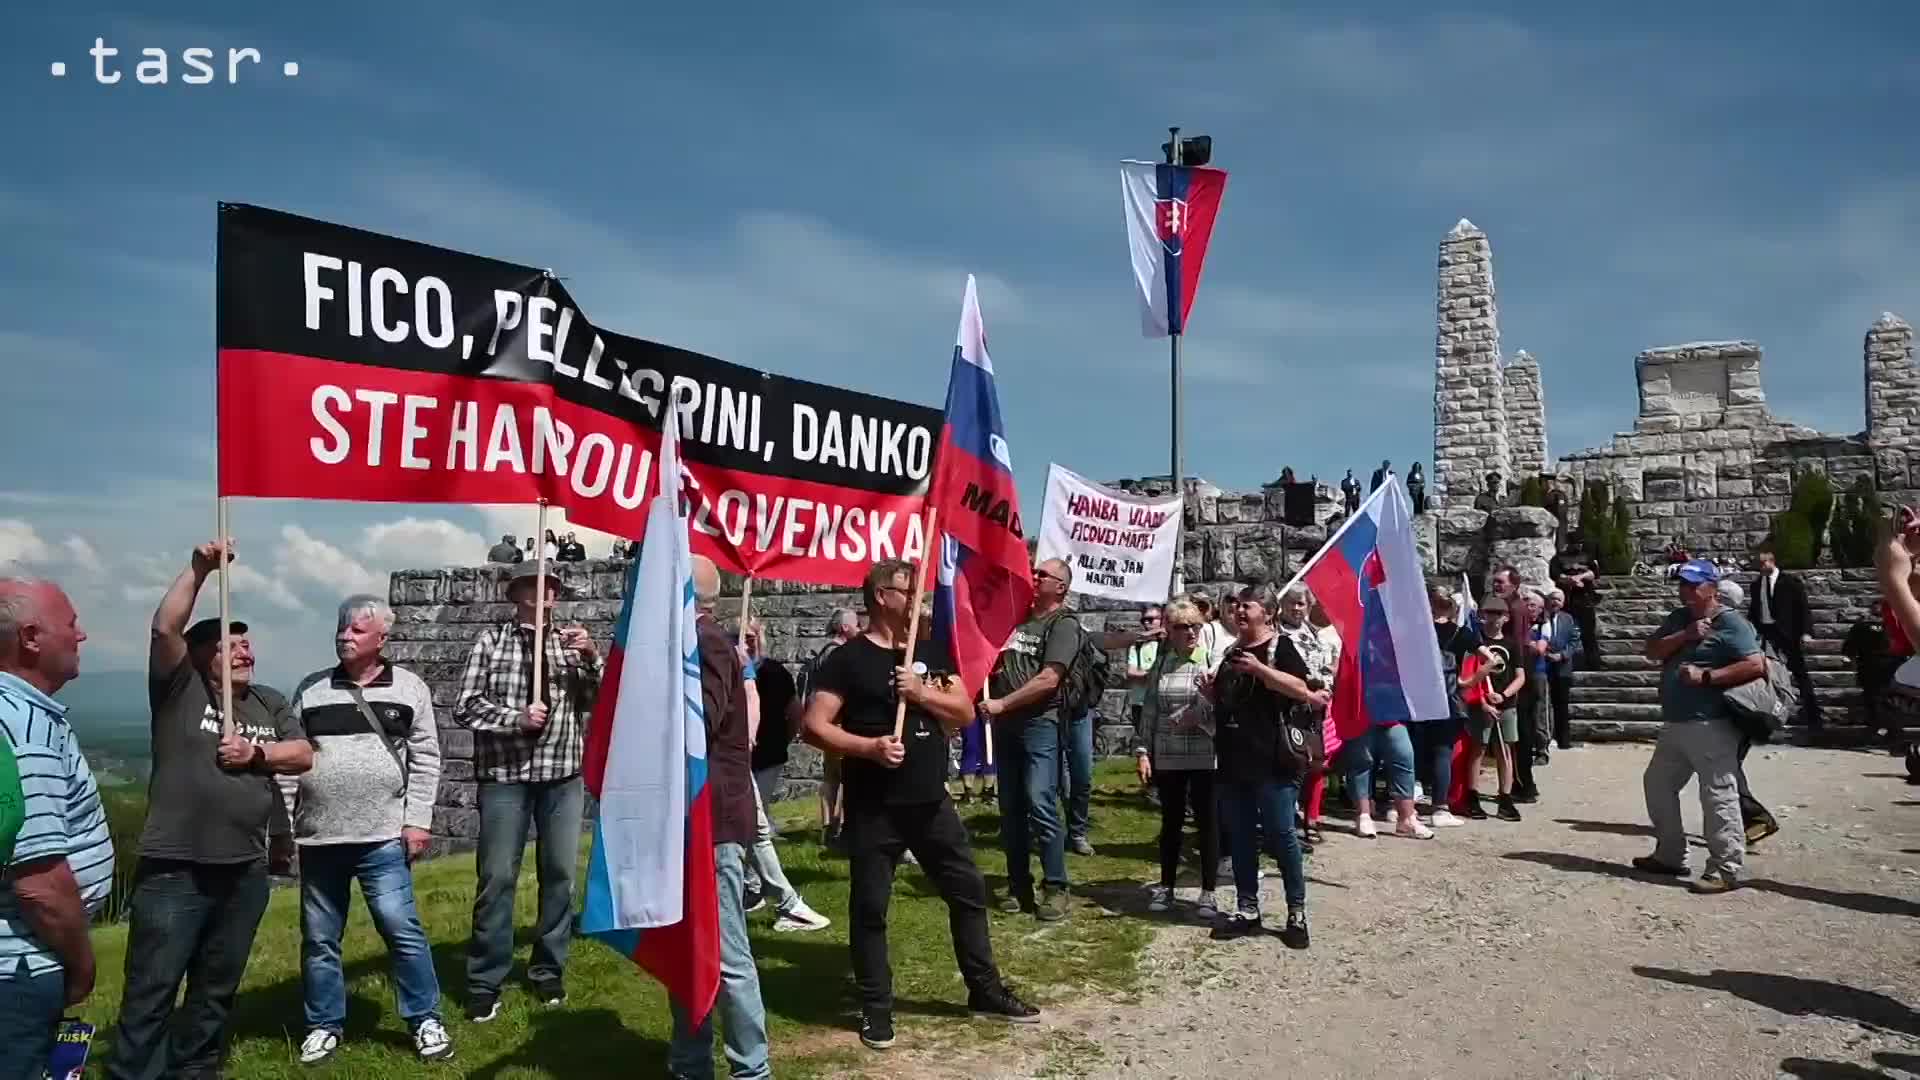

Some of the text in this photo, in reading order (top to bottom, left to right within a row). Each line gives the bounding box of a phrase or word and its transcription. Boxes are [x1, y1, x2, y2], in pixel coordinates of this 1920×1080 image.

[303, 251, 474, 360] FICO,
[792, 403, 931, 481] DANKO
[309, 384, 438, 470] STE
[678, 458, 926, 562] LOVENSKA
[1067, 491, 1119, 522] HANBA
[1070, 521, 1117, 546] FICOVEJ
[1077, 553, 1144, 574] ALL FOR JAN
[1086, 571, 1125, 588] MARTINA
